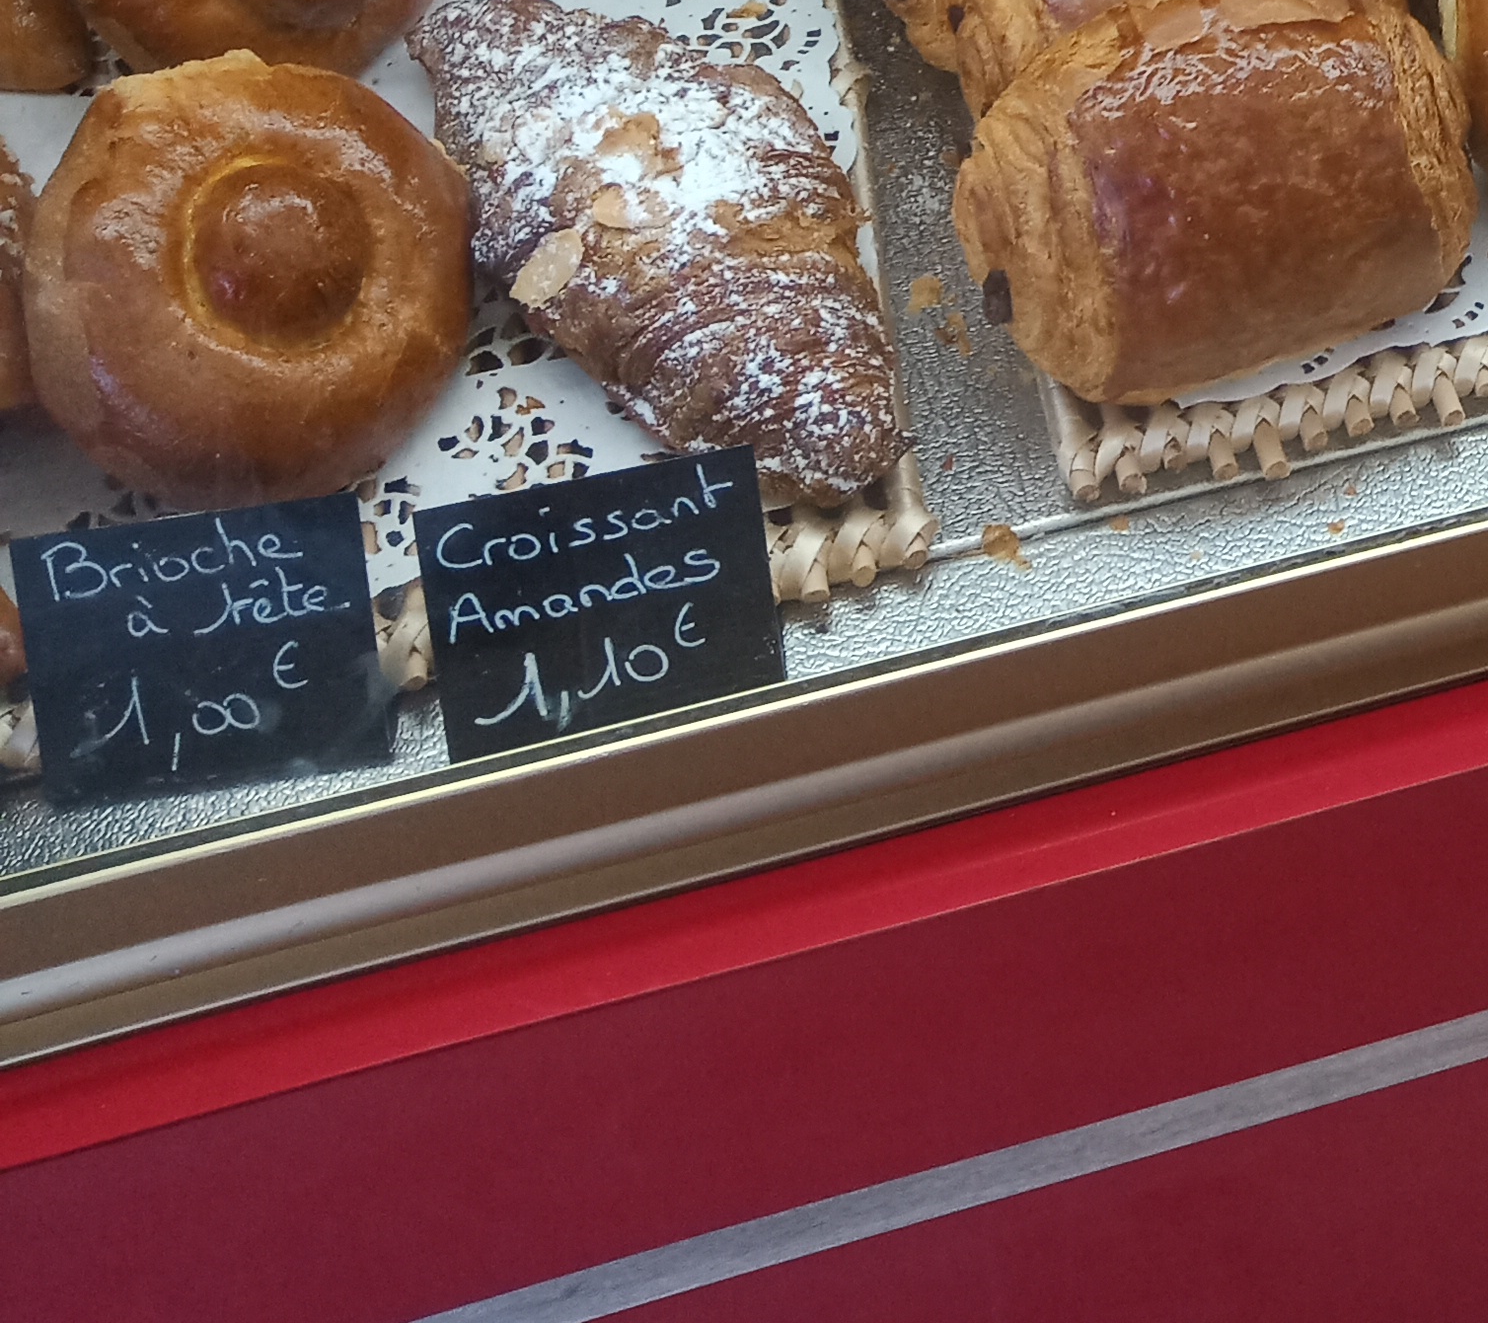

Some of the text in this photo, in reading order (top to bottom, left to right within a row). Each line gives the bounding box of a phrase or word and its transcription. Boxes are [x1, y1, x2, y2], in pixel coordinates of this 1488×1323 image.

[41, 517, 303, 602] Brioche
[436, 463, 734, 569] Croissant
[127, 566, 351, 638] à tête
[450, 549, 721, 644] Amandes
